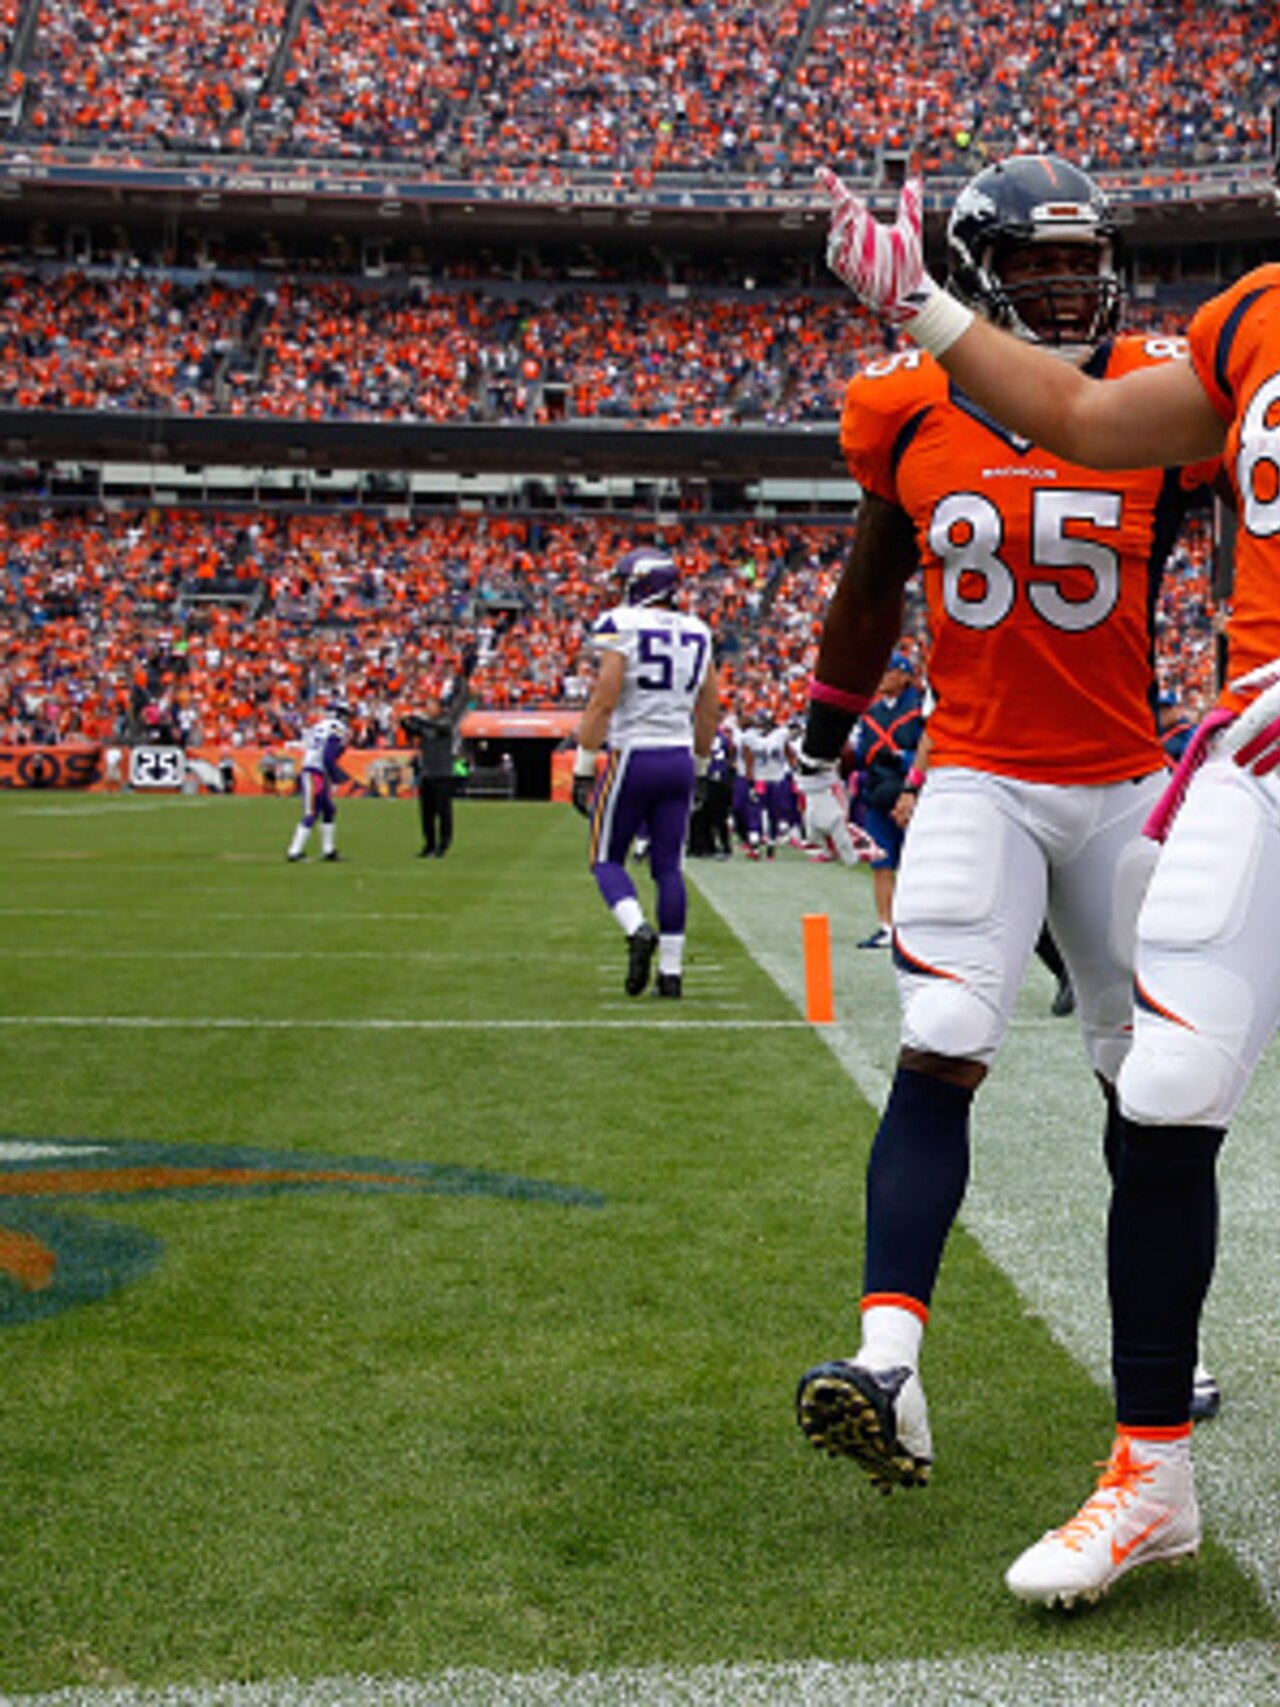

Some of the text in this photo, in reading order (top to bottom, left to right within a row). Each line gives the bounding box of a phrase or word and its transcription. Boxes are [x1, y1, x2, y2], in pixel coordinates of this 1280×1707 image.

[928, 490, 1122, 632] 85
[638, 629, 707, 694] 57
[0, 752, 103, 790] OS
[137, 752, 180, 782] 25
